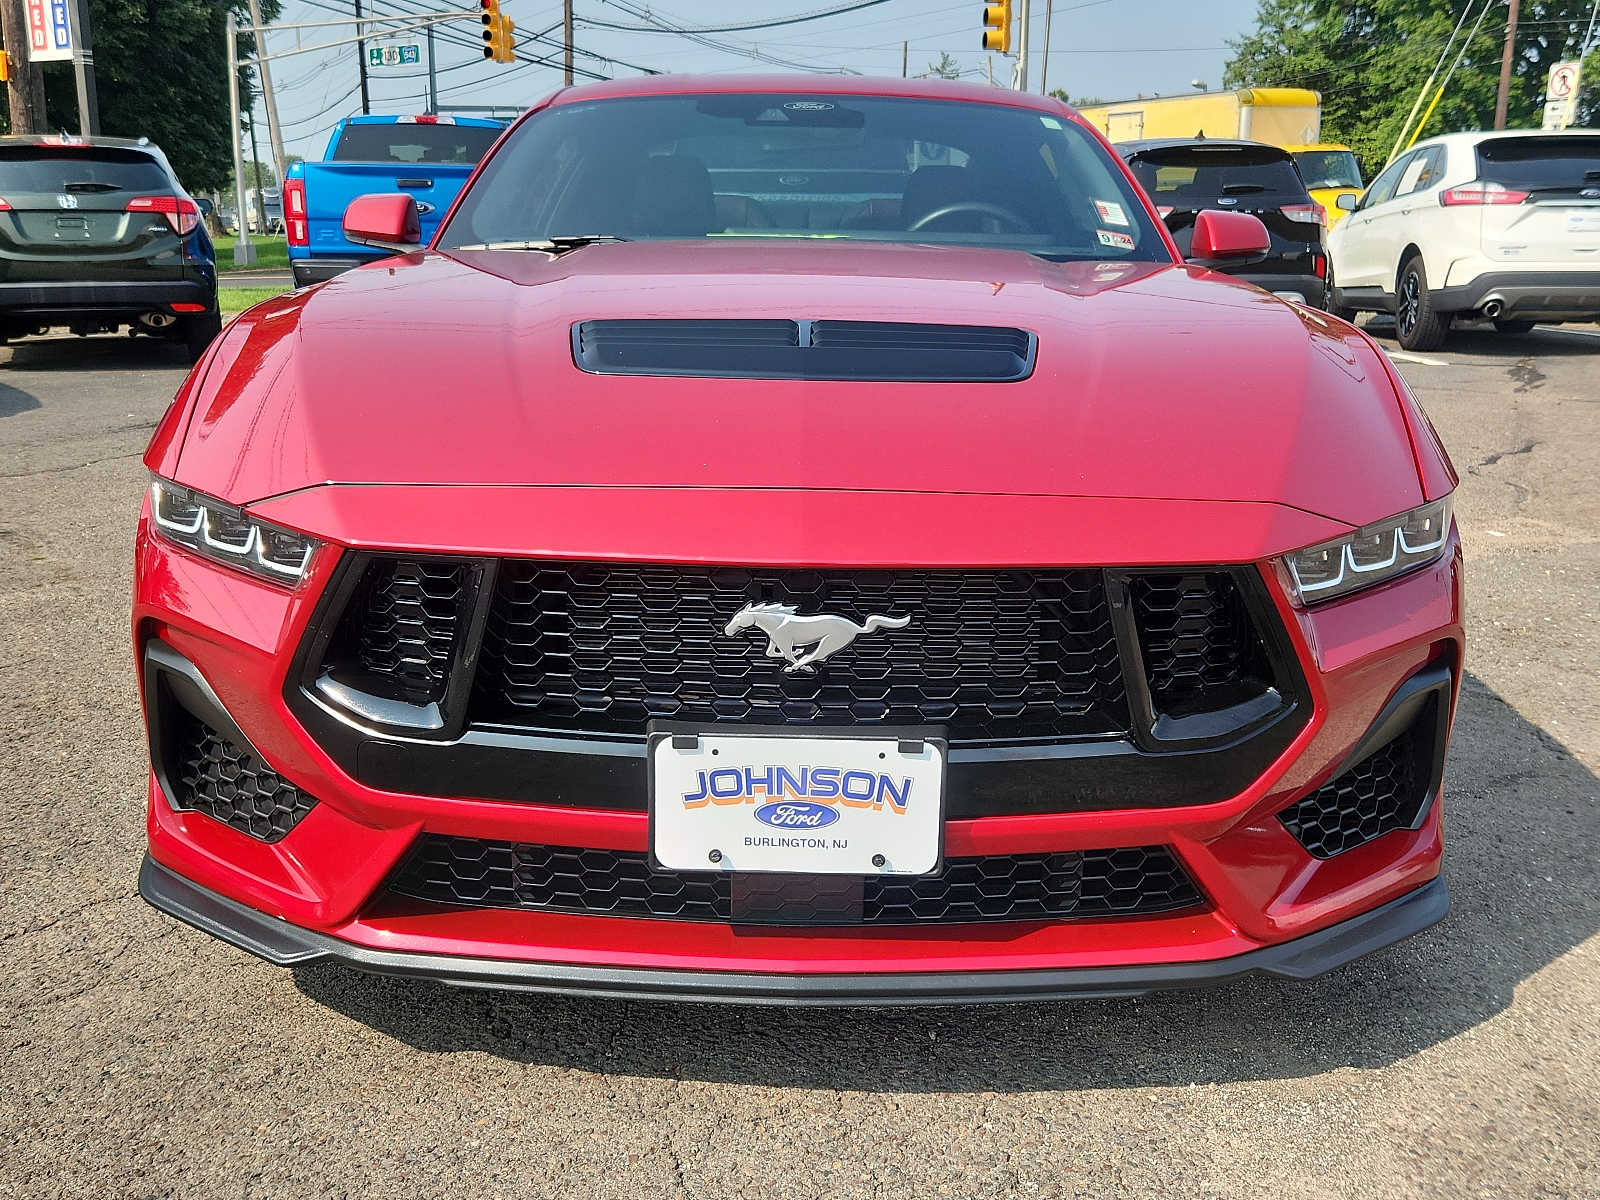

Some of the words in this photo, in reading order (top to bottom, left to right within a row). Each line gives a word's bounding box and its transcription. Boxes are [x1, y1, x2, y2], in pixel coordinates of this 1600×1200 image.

[54, 0, 67, 46] ED
[384, 50, 398, 61] 130
[1101, 234, 1110, 243] 9
[682, 765, 913, 814] JOHNSON
[770, 804, 822, 827] Ford
[744, 836, 829, 850] BURLINGTON,
[832, 839, 849, 850] NJ
